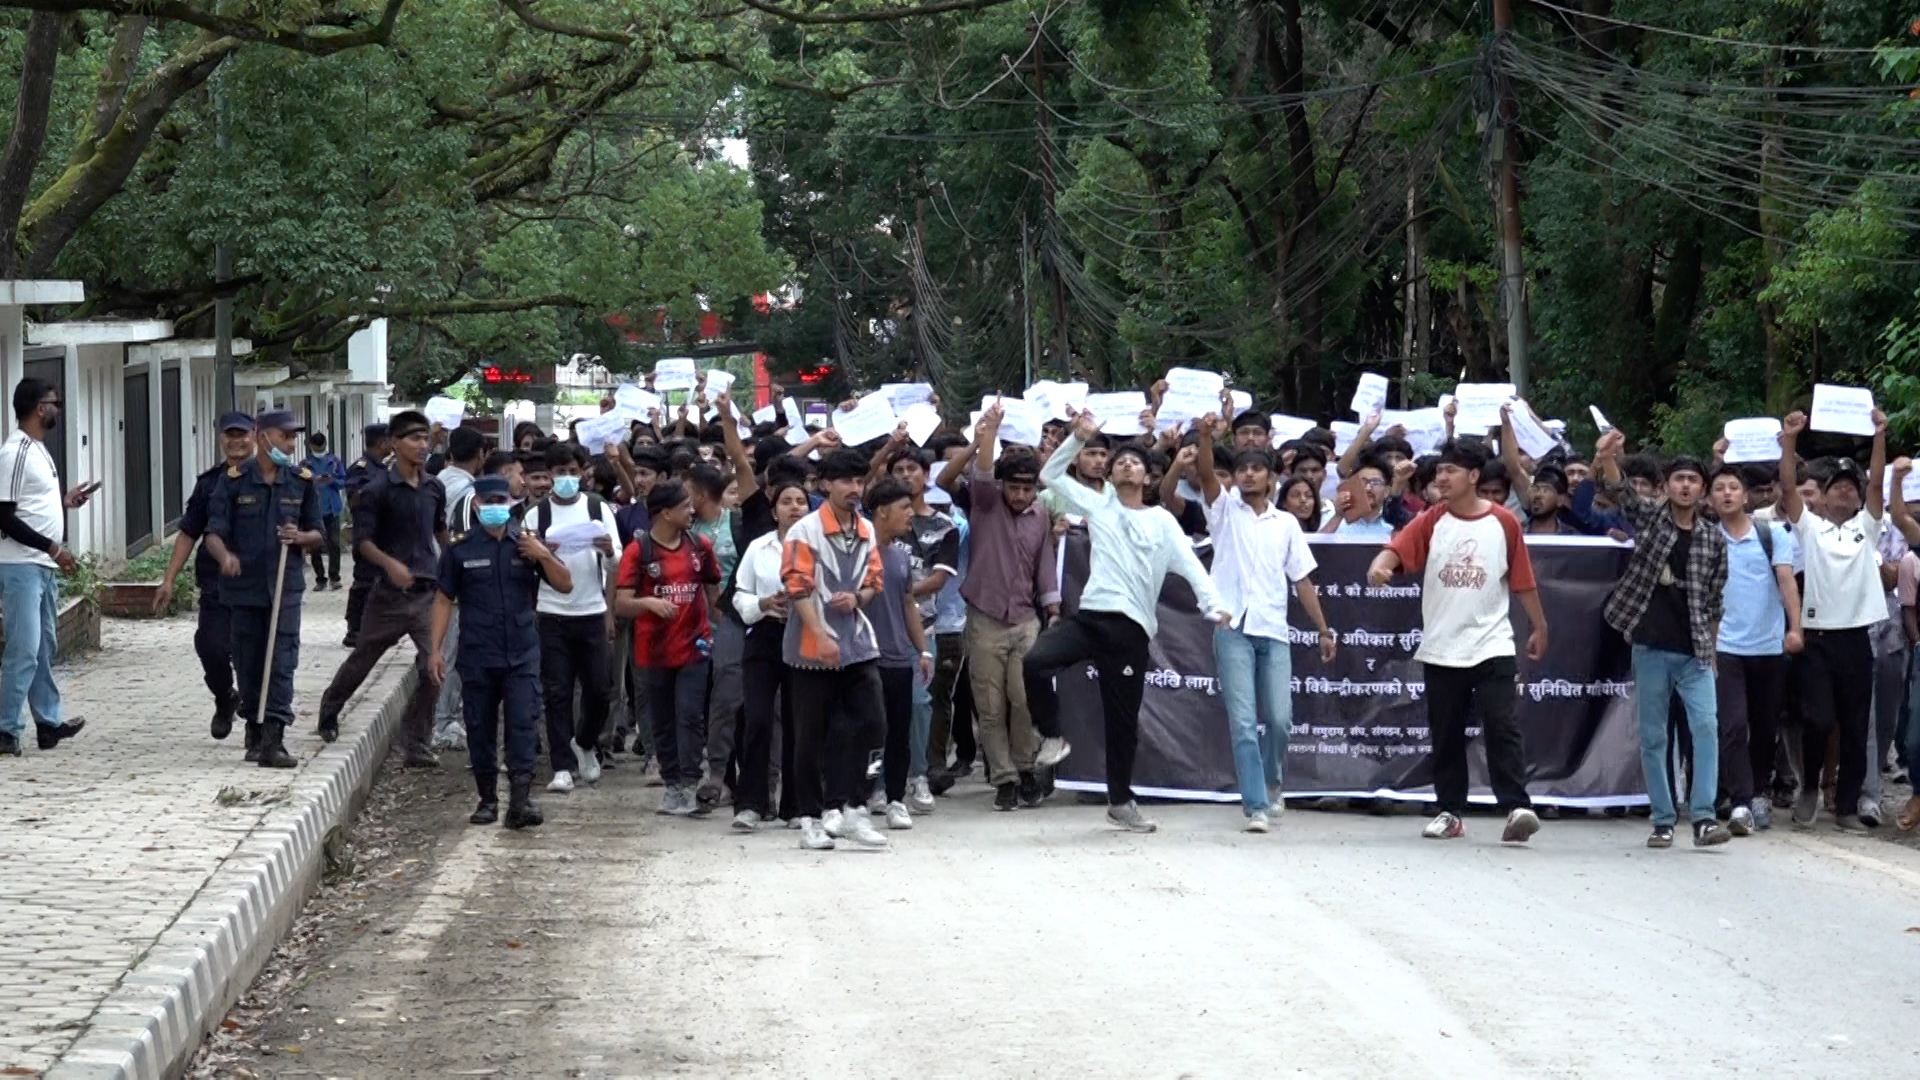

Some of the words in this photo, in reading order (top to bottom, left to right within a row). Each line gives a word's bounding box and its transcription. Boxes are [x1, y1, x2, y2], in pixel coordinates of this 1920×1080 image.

[653, 582, 700, 596] Emirate
[1342, 628, 1395, 646] अधिकार
[1365, 657, 1377, 672] र
[1184, 674, 1216, 696] लागू
